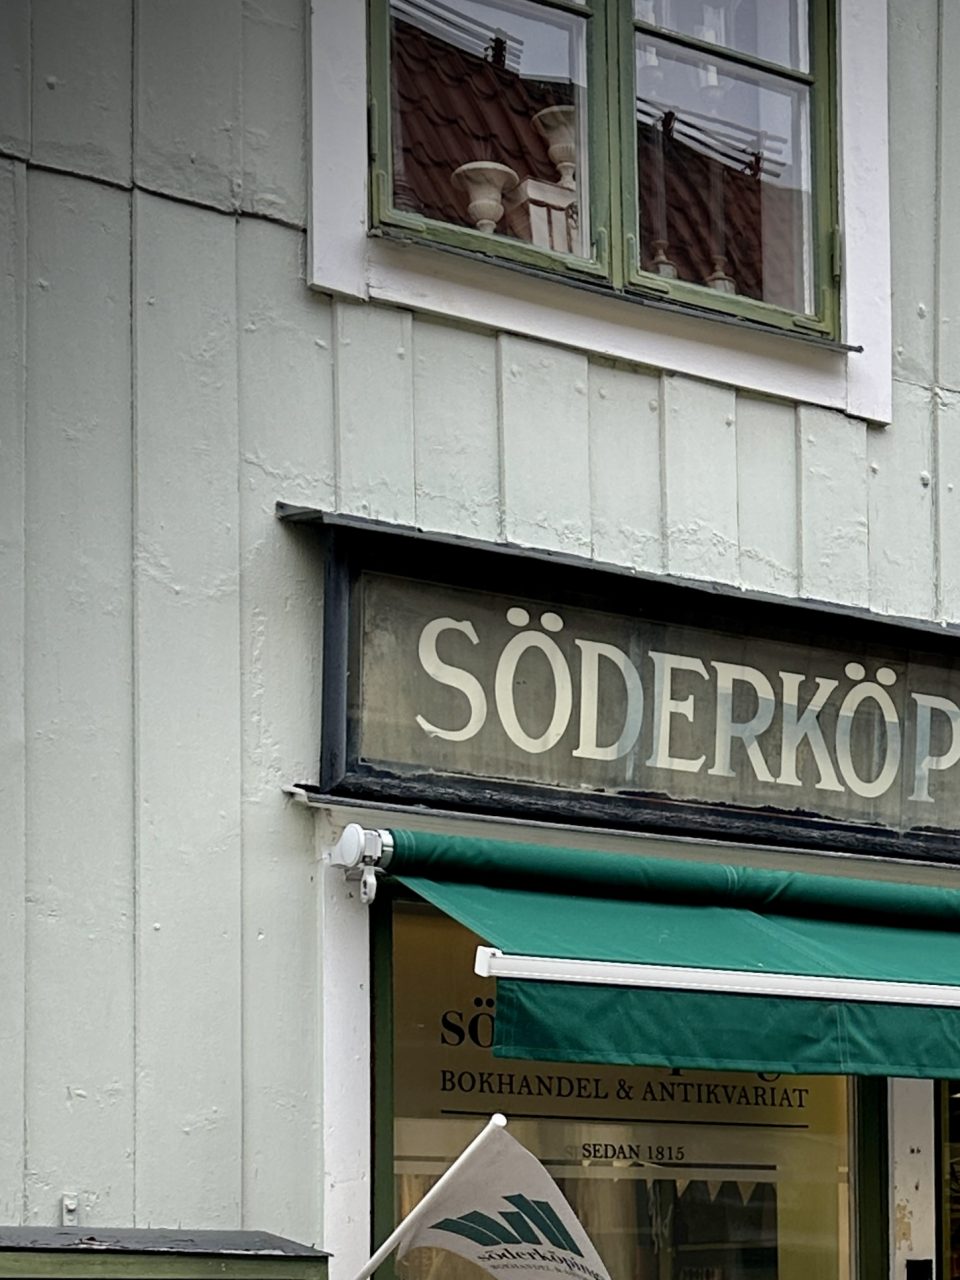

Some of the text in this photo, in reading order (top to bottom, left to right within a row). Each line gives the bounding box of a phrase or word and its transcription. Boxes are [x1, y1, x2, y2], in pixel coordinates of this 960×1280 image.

[440, 1069, 809, 1109] BOKHANDEL & ANTIKVARIAT
[582, 1143, 685, 1161] SEDAN 1815
